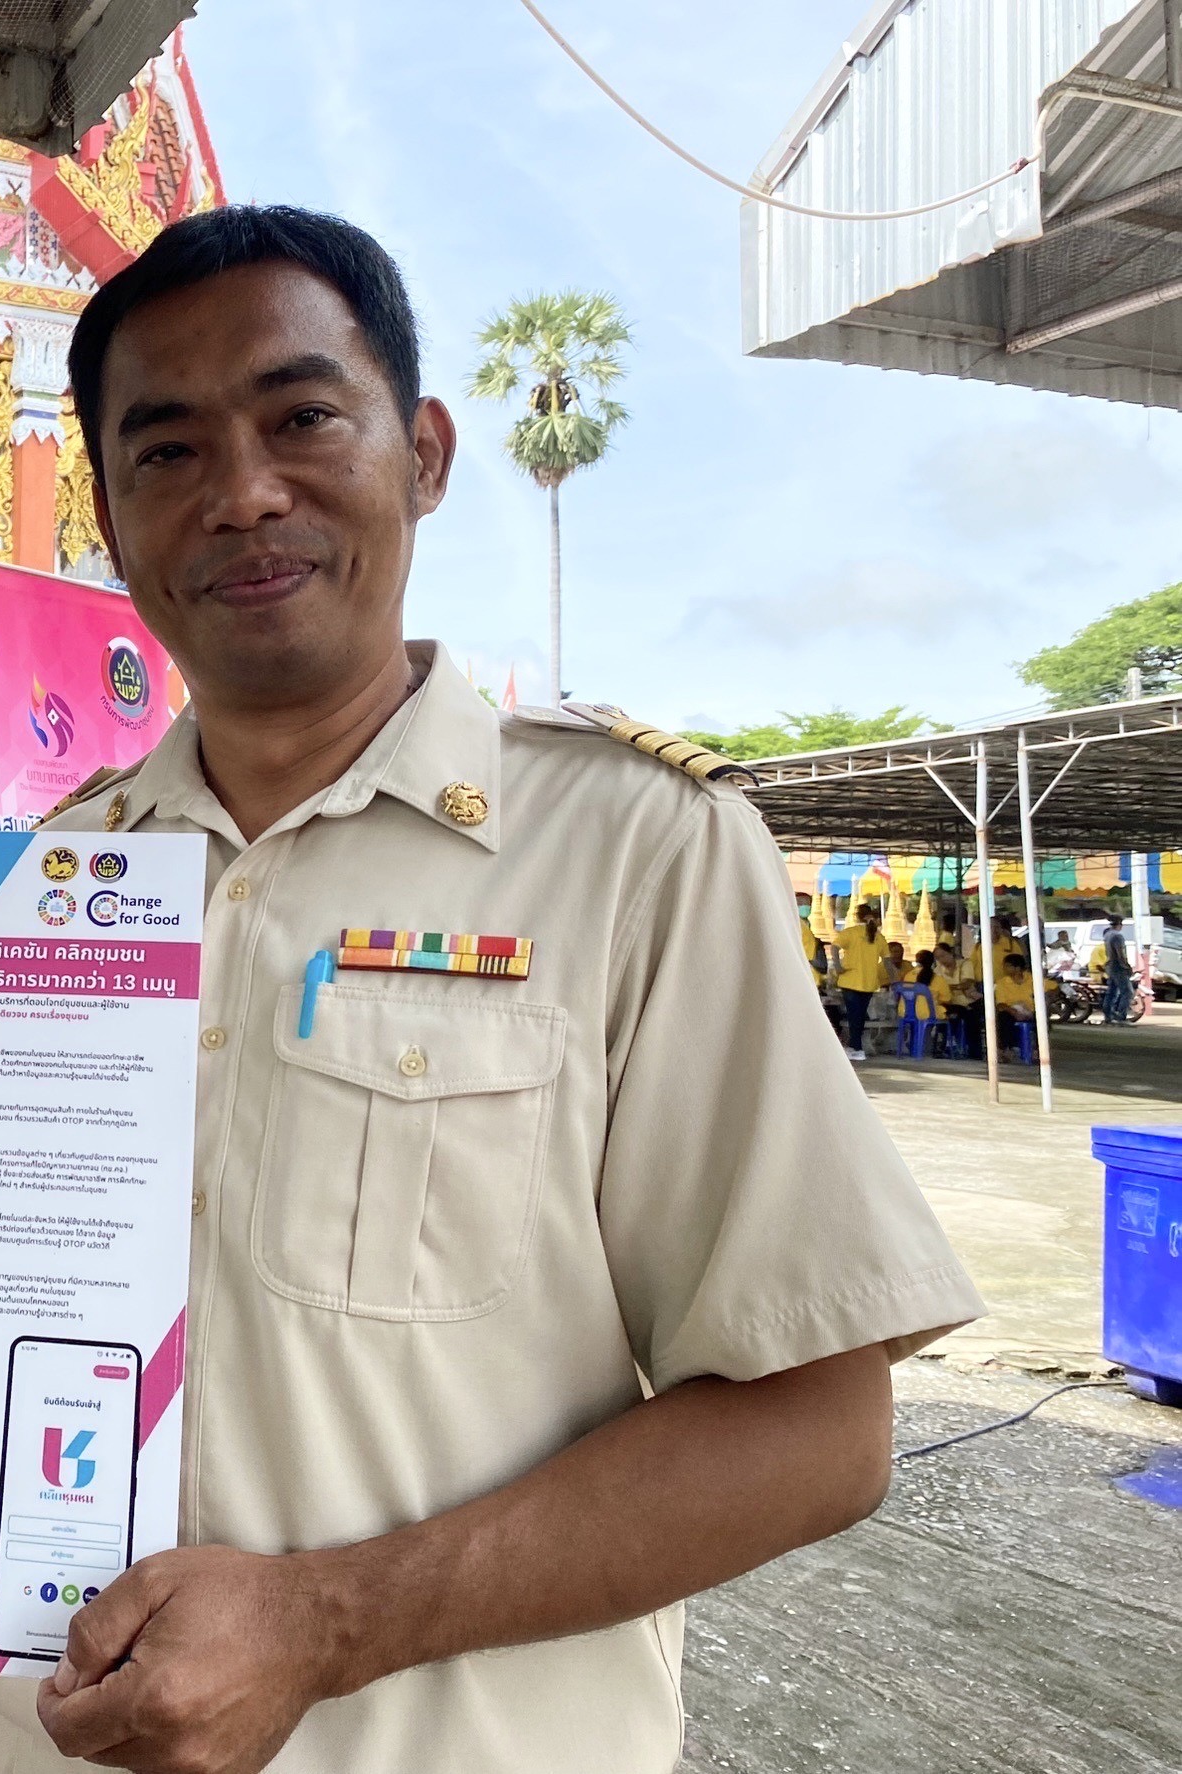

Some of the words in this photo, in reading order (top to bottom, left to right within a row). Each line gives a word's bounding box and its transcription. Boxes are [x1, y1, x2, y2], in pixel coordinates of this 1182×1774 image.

[26, 769, 81, 786] บทบาทสตรี
[119, 912, 139, 925] for
[143, 913, 180, 926] Good
[54, 944, 146, 967] คลิกชุมชน
[112, 975, 136, 990] 13
[142, 977, 177, 997] เมนู
[30, 1009, 89, 1021] ครบเรื่องชุมชน
[62, 1117, 84, 1125] OTOP
[63, 1240, 86, 1248] OTOP
[44, 1397, 102, 1412] ยินดีต้อนรับเข้าสู่
